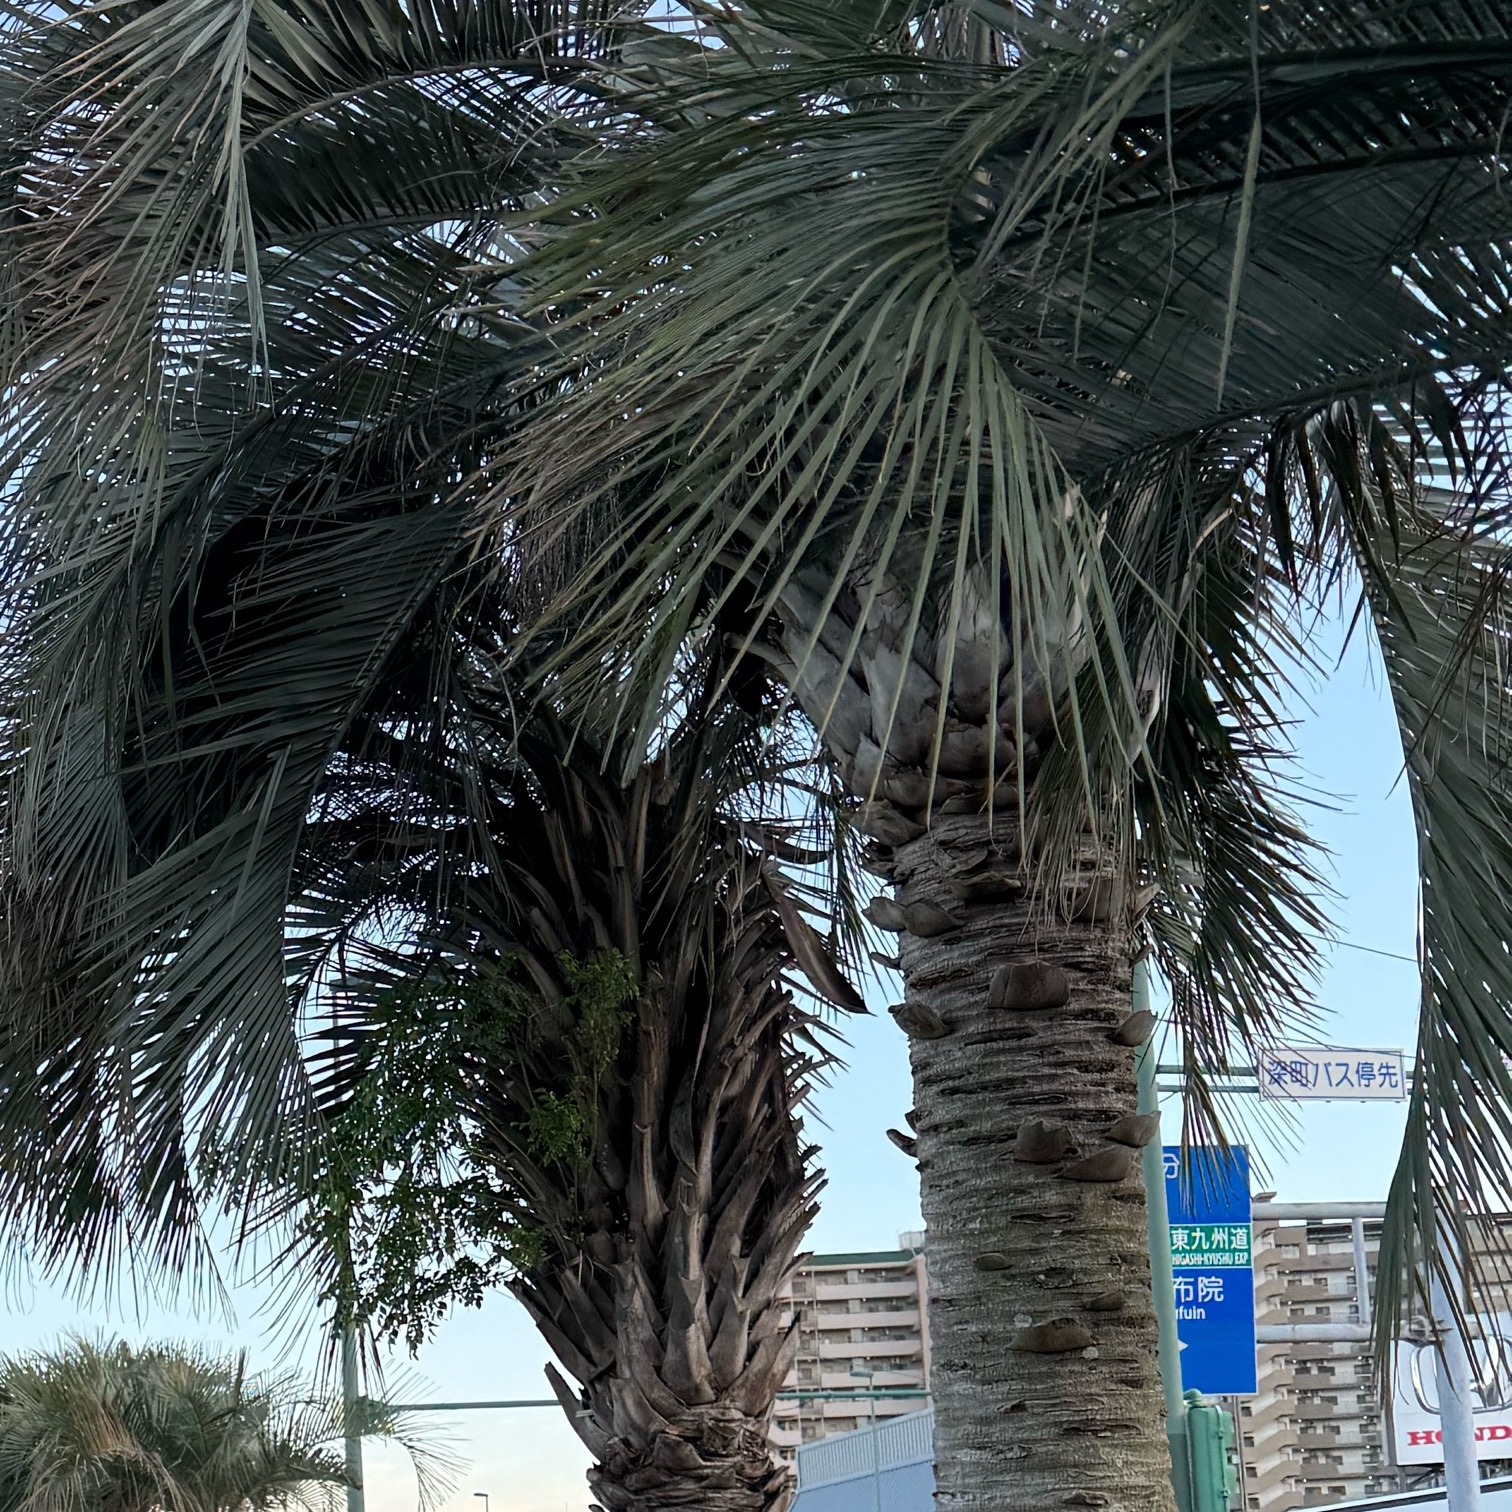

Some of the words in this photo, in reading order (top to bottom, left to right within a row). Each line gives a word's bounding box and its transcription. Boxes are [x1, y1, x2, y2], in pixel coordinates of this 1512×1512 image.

[1268, 1060, 1399, 1089] 深町バス停先
[1171, 1226, 1249, 1250] 東九州道
[1172, 1252, 1233, 1266] HIGASHI-KYUSHU
[1234, 1251, 1249, 1265] EXP
[1176, 1305, 1206, 1320] fuin
